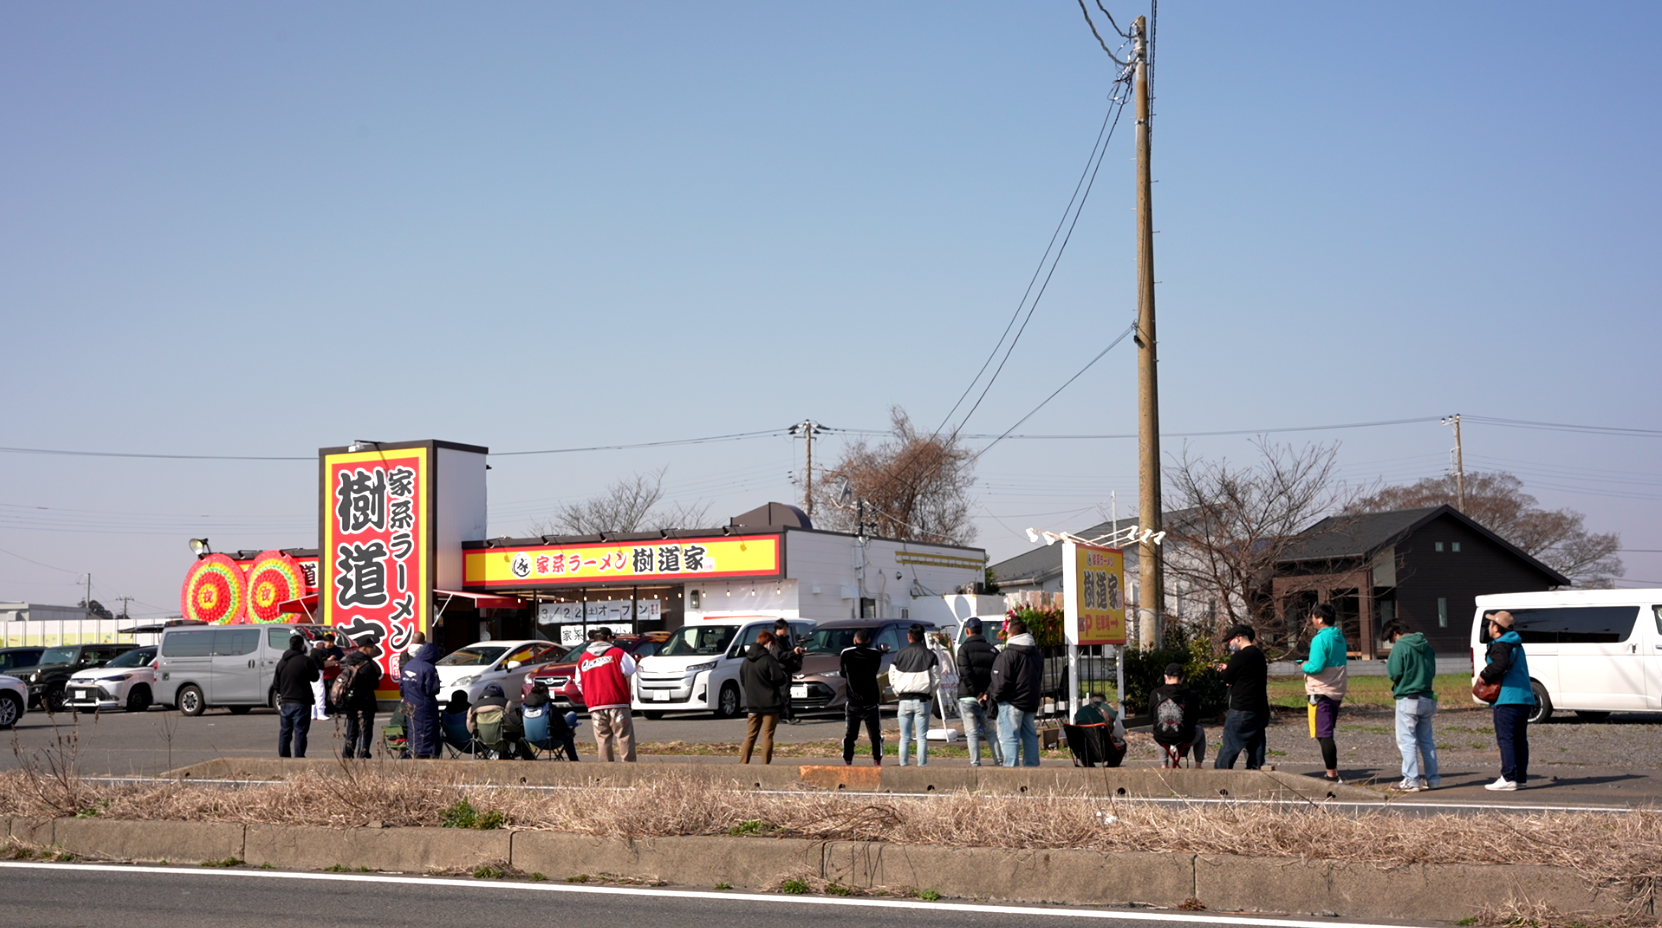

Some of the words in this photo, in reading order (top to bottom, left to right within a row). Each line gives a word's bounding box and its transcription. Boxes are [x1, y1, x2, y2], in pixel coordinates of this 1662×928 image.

[388, 468, 414, 650] 家系ラーメン
[536, 553, 627, 574] 家系ラーメン
[632, 545, 706, 573] 樹道家
[1083, 569, 1118, 609] 樹道家
[1085, 614, 1093, 637] P
